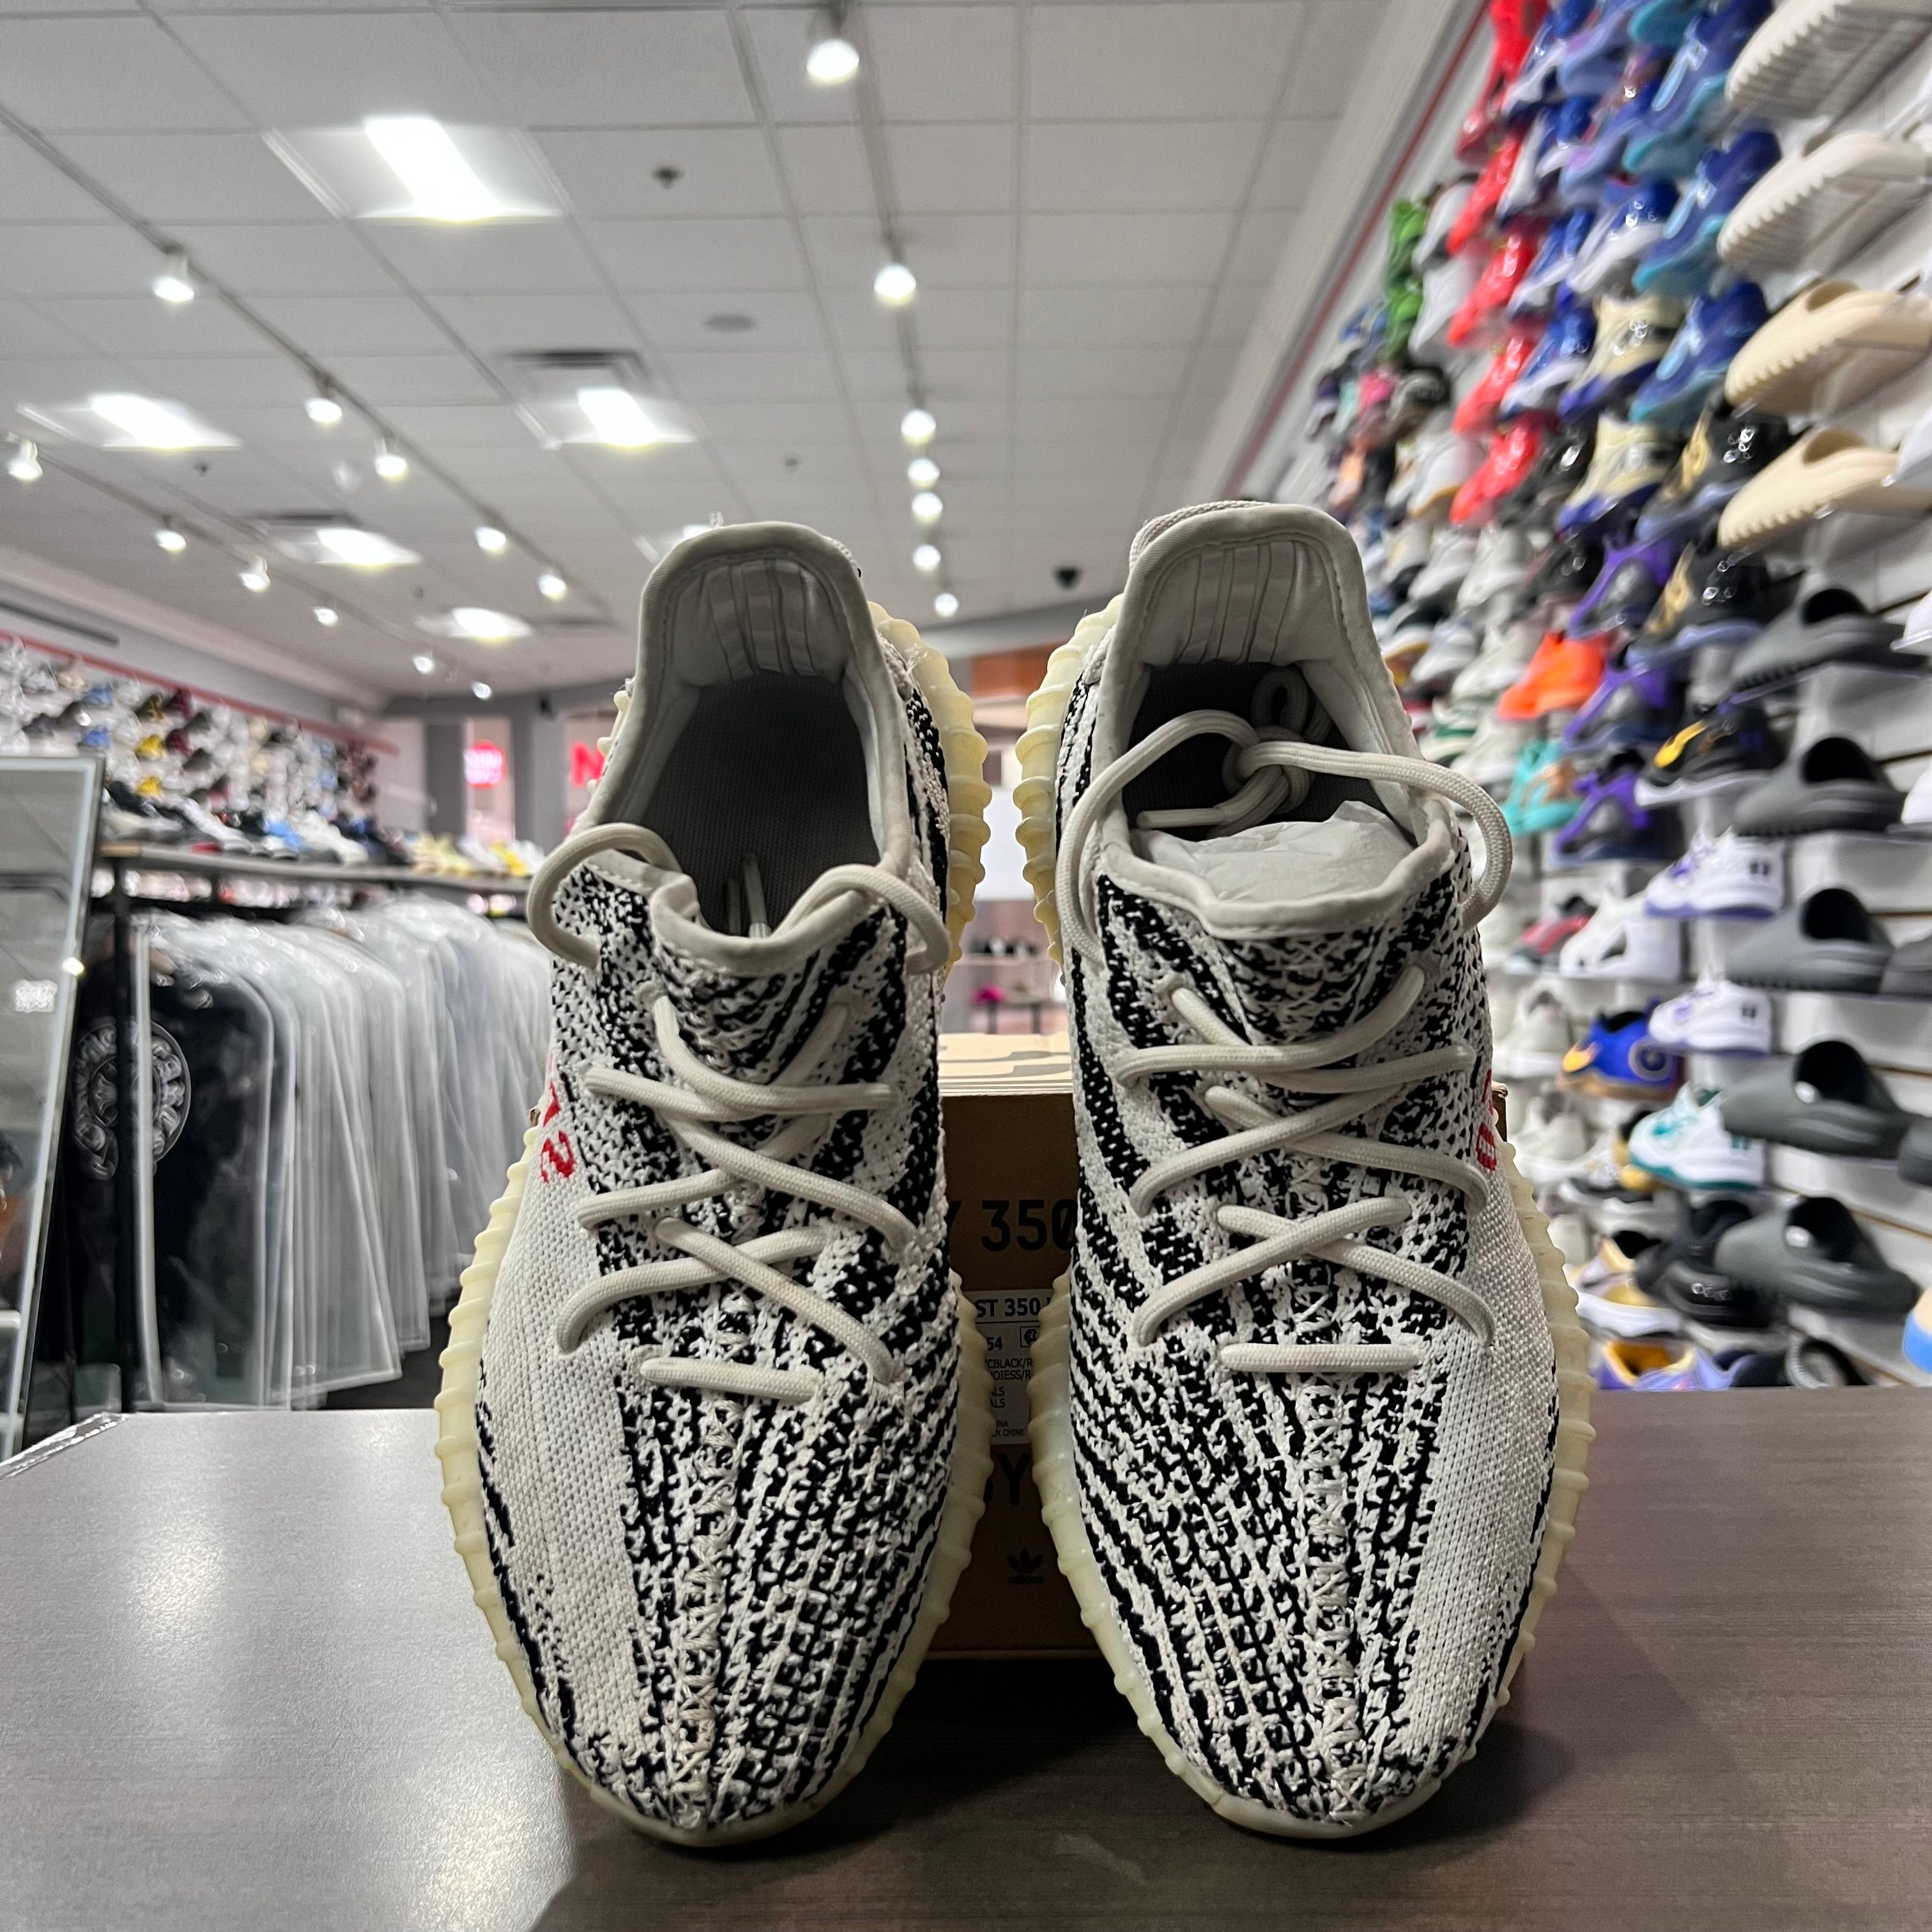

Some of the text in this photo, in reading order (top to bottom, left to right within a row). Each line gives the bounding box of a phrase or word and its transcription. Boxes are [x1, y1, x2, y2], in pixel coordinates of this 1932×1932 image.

[981, 1199, 1078, 1252] 350
[974, 1298, 1041, 1317] ST 350
[986, 1337, 1002, 1351] 54
[985, 1358, 1033, 1368] CBLACK/R
[991, 1370, 1032, 1381] OIESS/R
